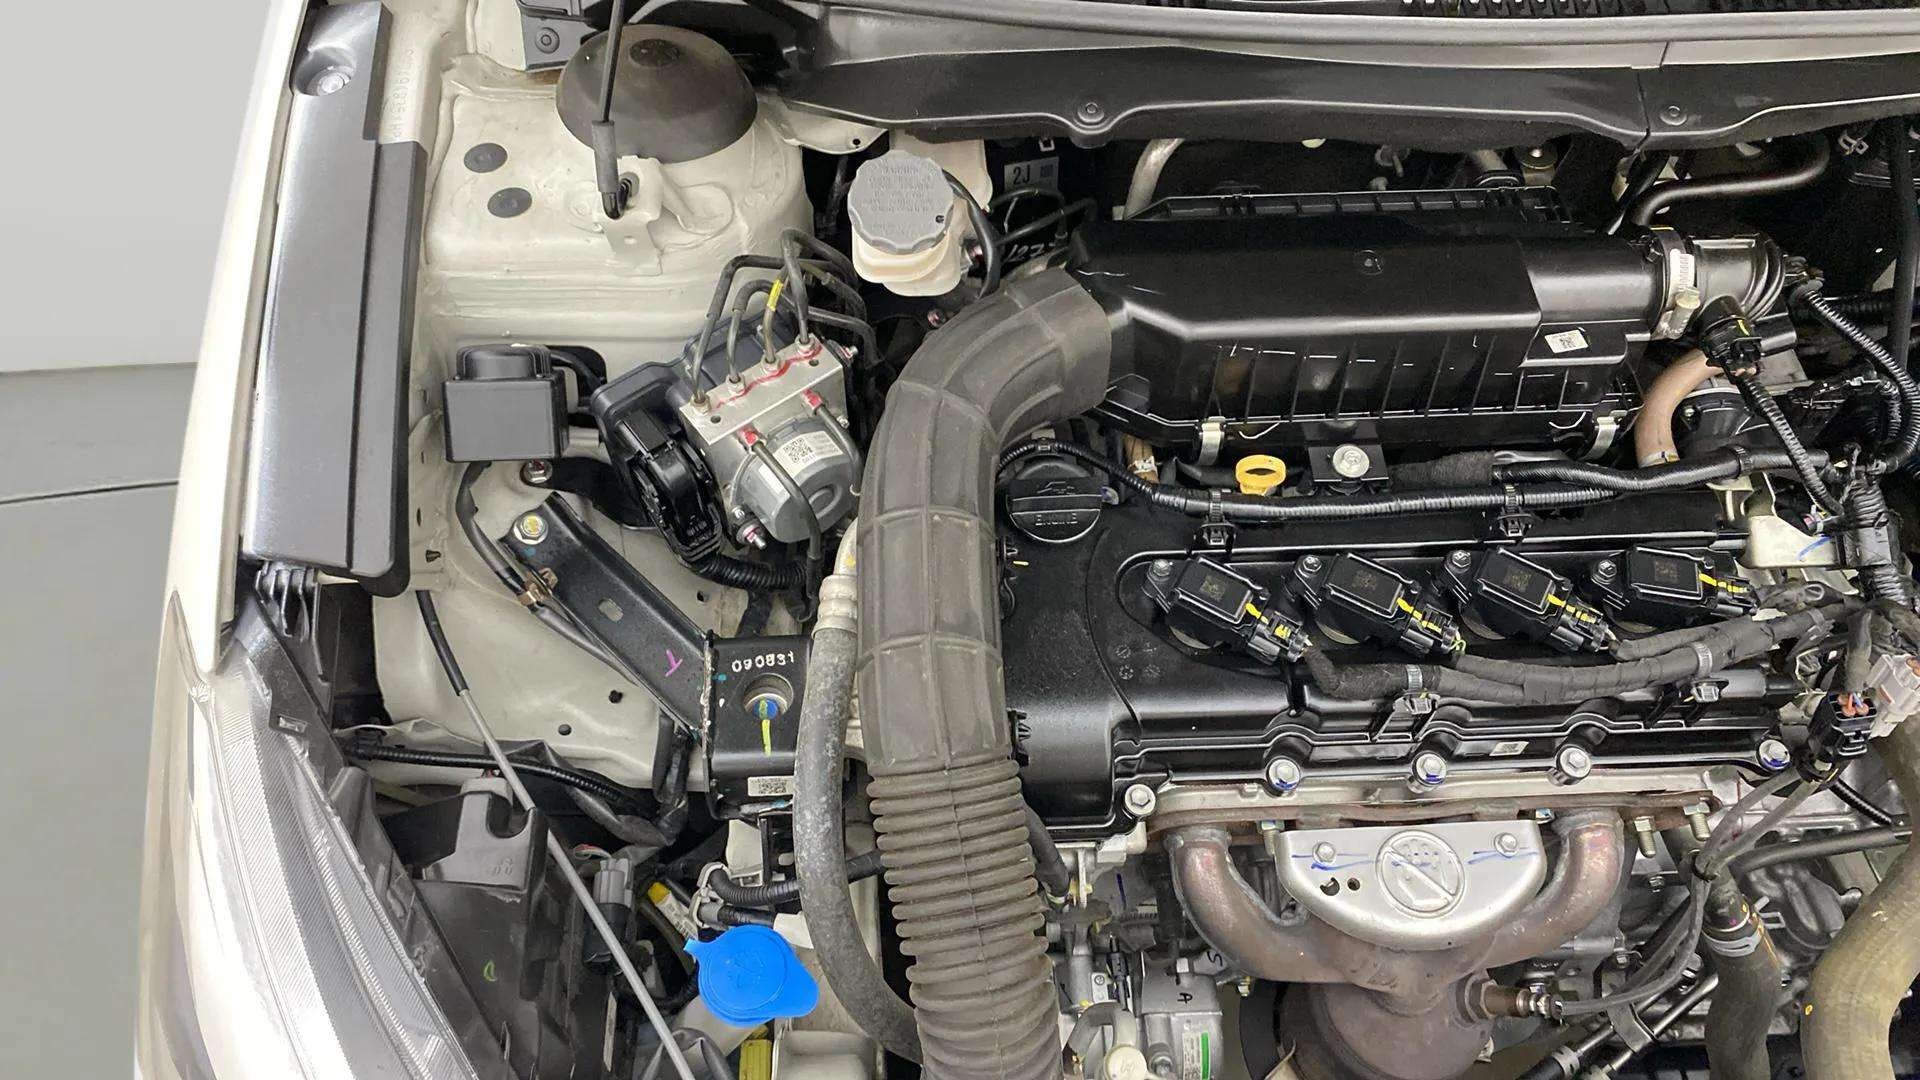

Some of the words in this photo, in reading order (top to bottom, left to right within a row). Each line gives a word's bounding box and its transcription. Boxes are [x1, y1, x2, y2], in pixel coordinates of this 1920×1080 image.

[1012, 163, 1031, 186] 2J
[1034, 511, 1079, 527] ENGINE
[731, 650, 795, 673] 090831
